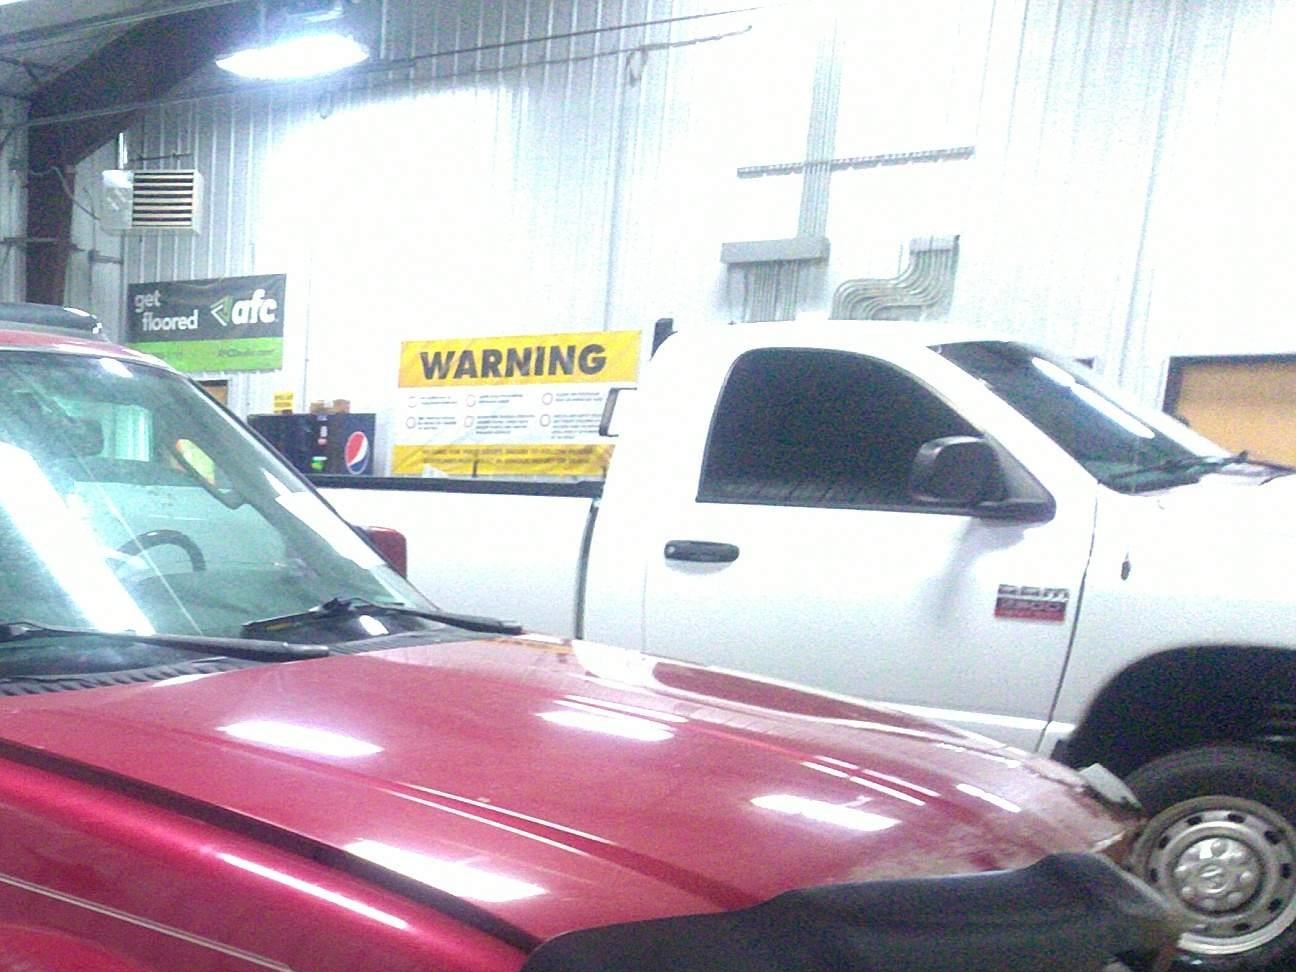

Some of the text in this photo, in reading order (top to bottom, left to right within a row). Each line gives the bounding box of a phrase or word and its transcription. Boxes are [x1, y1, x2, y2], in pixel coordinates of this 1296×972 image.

[134, 290, 162, 313] get
[231, 288, 278, 325] afc
[142, 309, 199, 332] floored
[419, 343, 608, 380] WARNING
